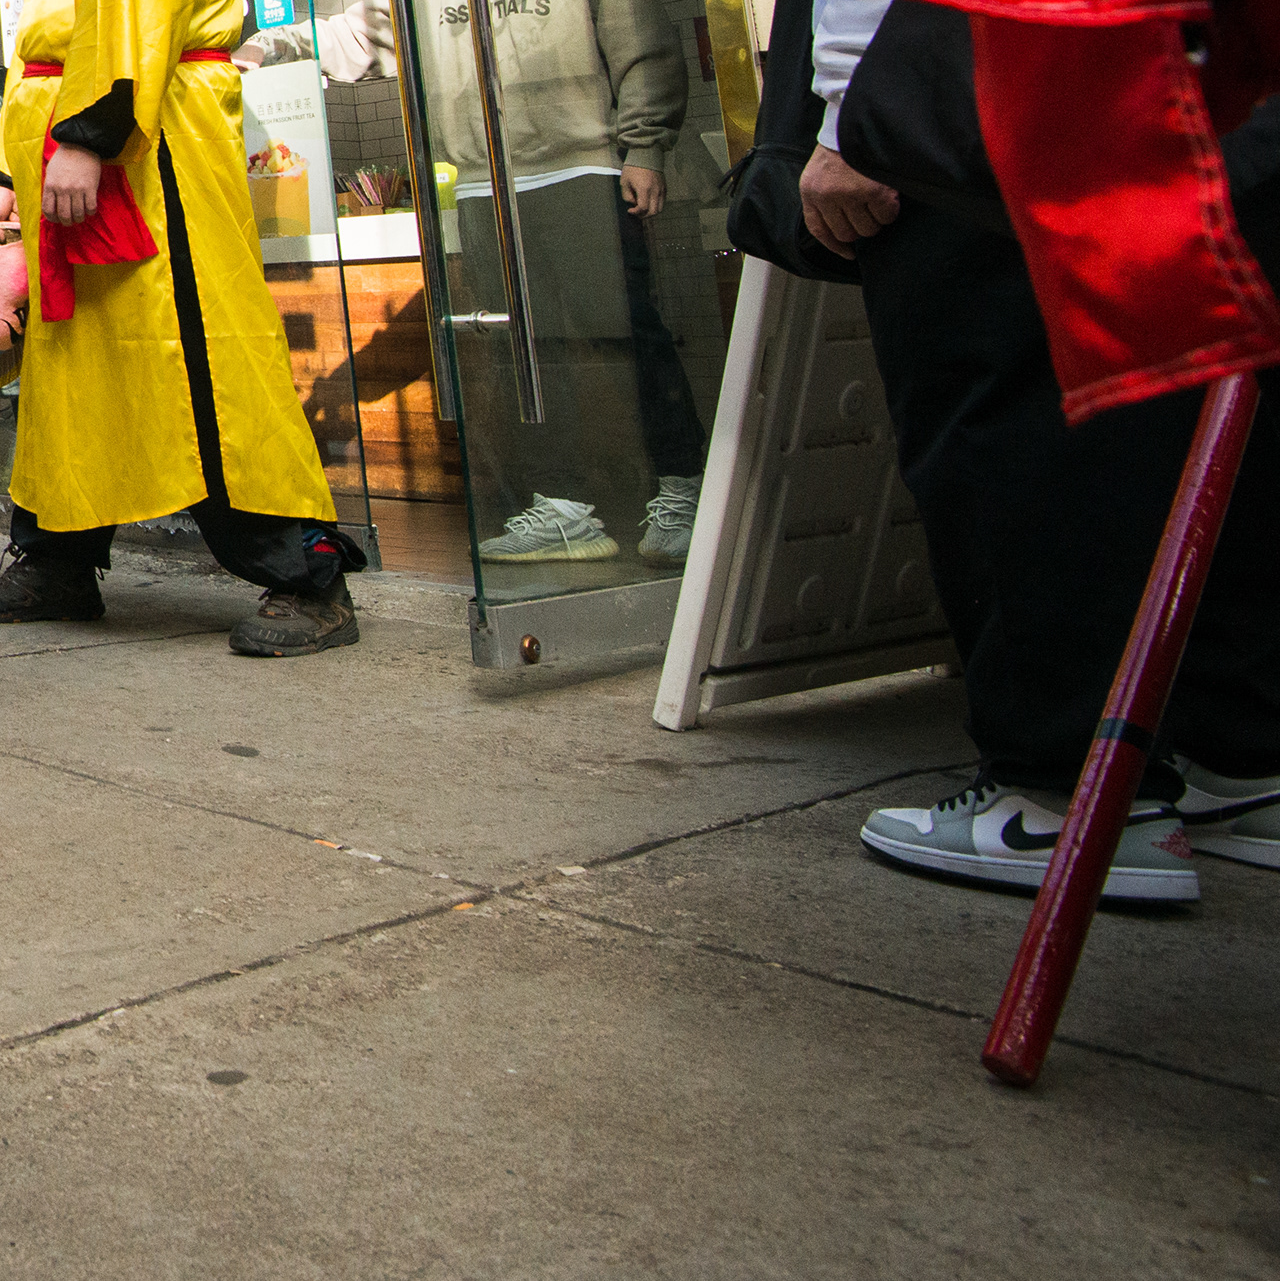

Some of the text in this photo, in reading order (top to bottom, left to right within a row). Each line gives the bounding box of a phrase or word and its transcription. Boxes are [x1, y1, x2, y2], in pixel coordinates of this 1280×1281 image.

[257, 98, 312, 116] 百香果水果茶
